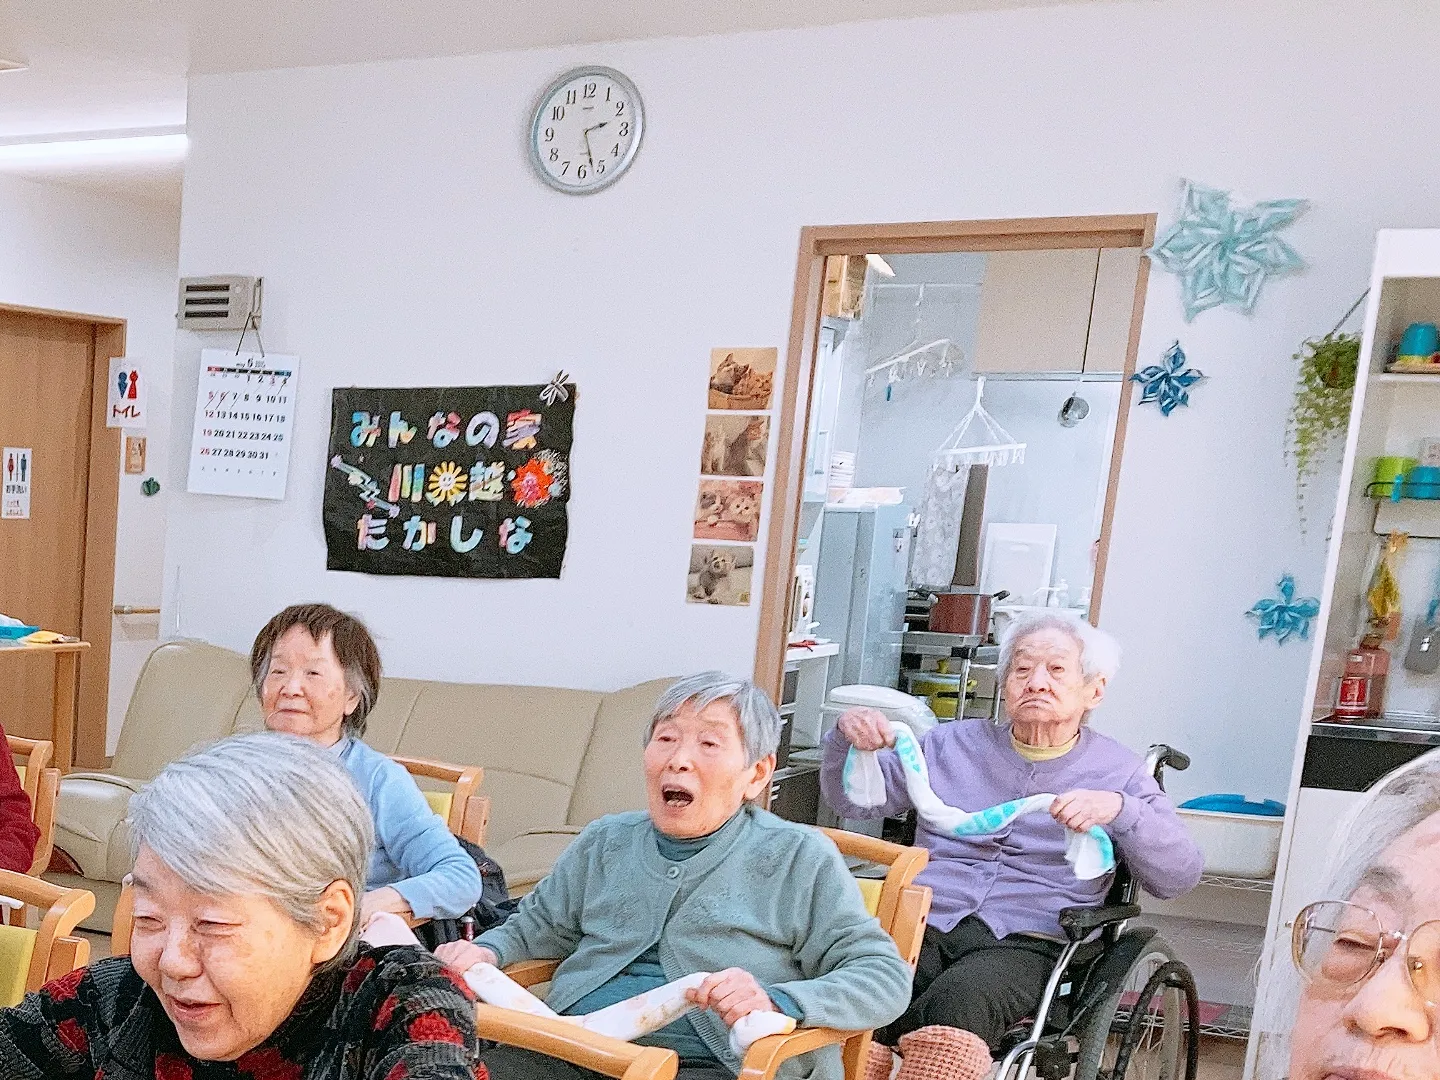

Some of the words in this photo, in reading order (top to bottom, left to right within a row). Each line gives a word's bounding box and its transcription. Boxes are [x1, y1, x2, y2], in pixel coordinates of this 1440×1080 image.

[566, 90, 576, 105] 11
[583, 83, 596, 98] 12
[605, 87, 611, 101] 1
[552, 106, 565, 120] 10
[615, 101, 624, 117] 2
[545, 127, 554, 141] 9
[619, 122, 628, 136] 3
[550, 148, 558, 161] 8
[611, 143, 619, 157] 4
[562, 161, 570, 175] 7
[578, 165, 586, 179] 6
[597, 160, 605, 173] 5
[244, 393, 249, 401] 8
[266, 395, 276, 403] 10
[279, 396, 287, 404] 11
[112, 404, 141, 418] トイレ
[205, 410, 214, 418] 12
[217, 411, 225, 419] 13
[229, 412, 238, 420] 14
[241, 412, 249, 420] 15
[252, 413, 261, 421] 16
[264, 414, 274, 422] 17
[277, 415, 285, 423] 18
[214, 430, 224, 438] 20
[226, 430, 235, 438] 21
[238, 431, 248, 439] 22
[249, 432, 259, 440] 23
[261, 433, 271, 441] 24
[274, 434, 283, 442] 25
[350, 408, 543, 450] みんなの家
[224, 449, 234, 457] 28
[235, 450, 246, 458] 29
[247, 451, 257, 459] 30
[259, 451, 269, 460] 31
[357, 513, 534, 555] たかしな
